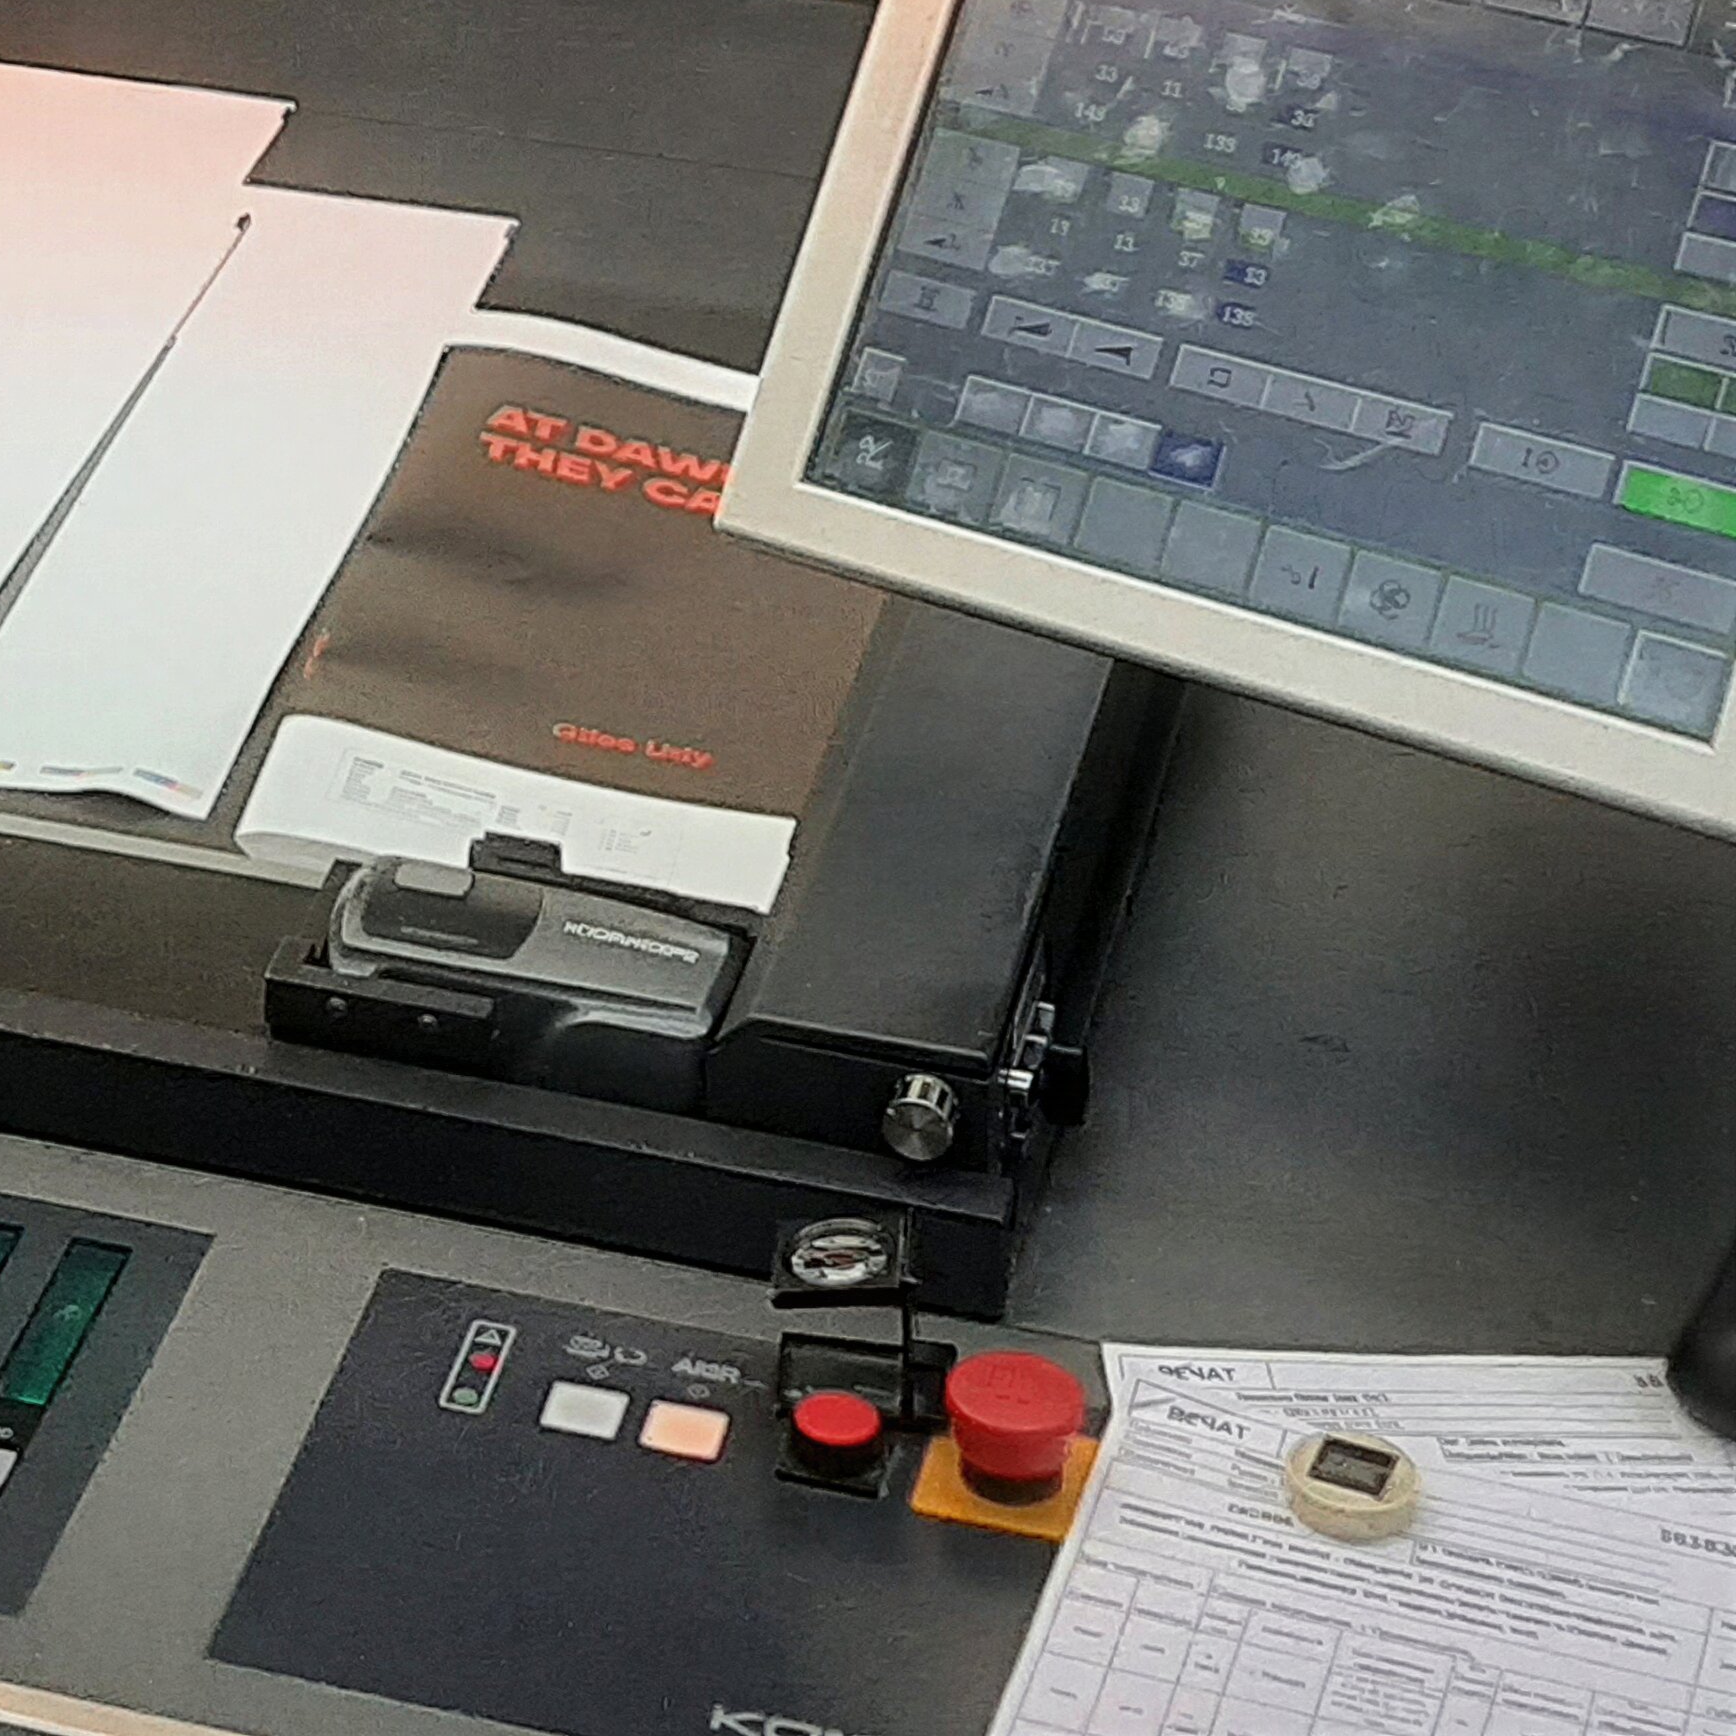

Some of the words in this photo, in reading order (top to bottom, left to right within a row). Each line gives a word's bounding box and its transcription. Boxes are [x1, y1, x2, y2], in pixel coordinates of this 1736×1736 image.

[487, 406, 567, 440] AT
[481, 432, 633, 490] THEY
[643, 477, 722, 515] CA
